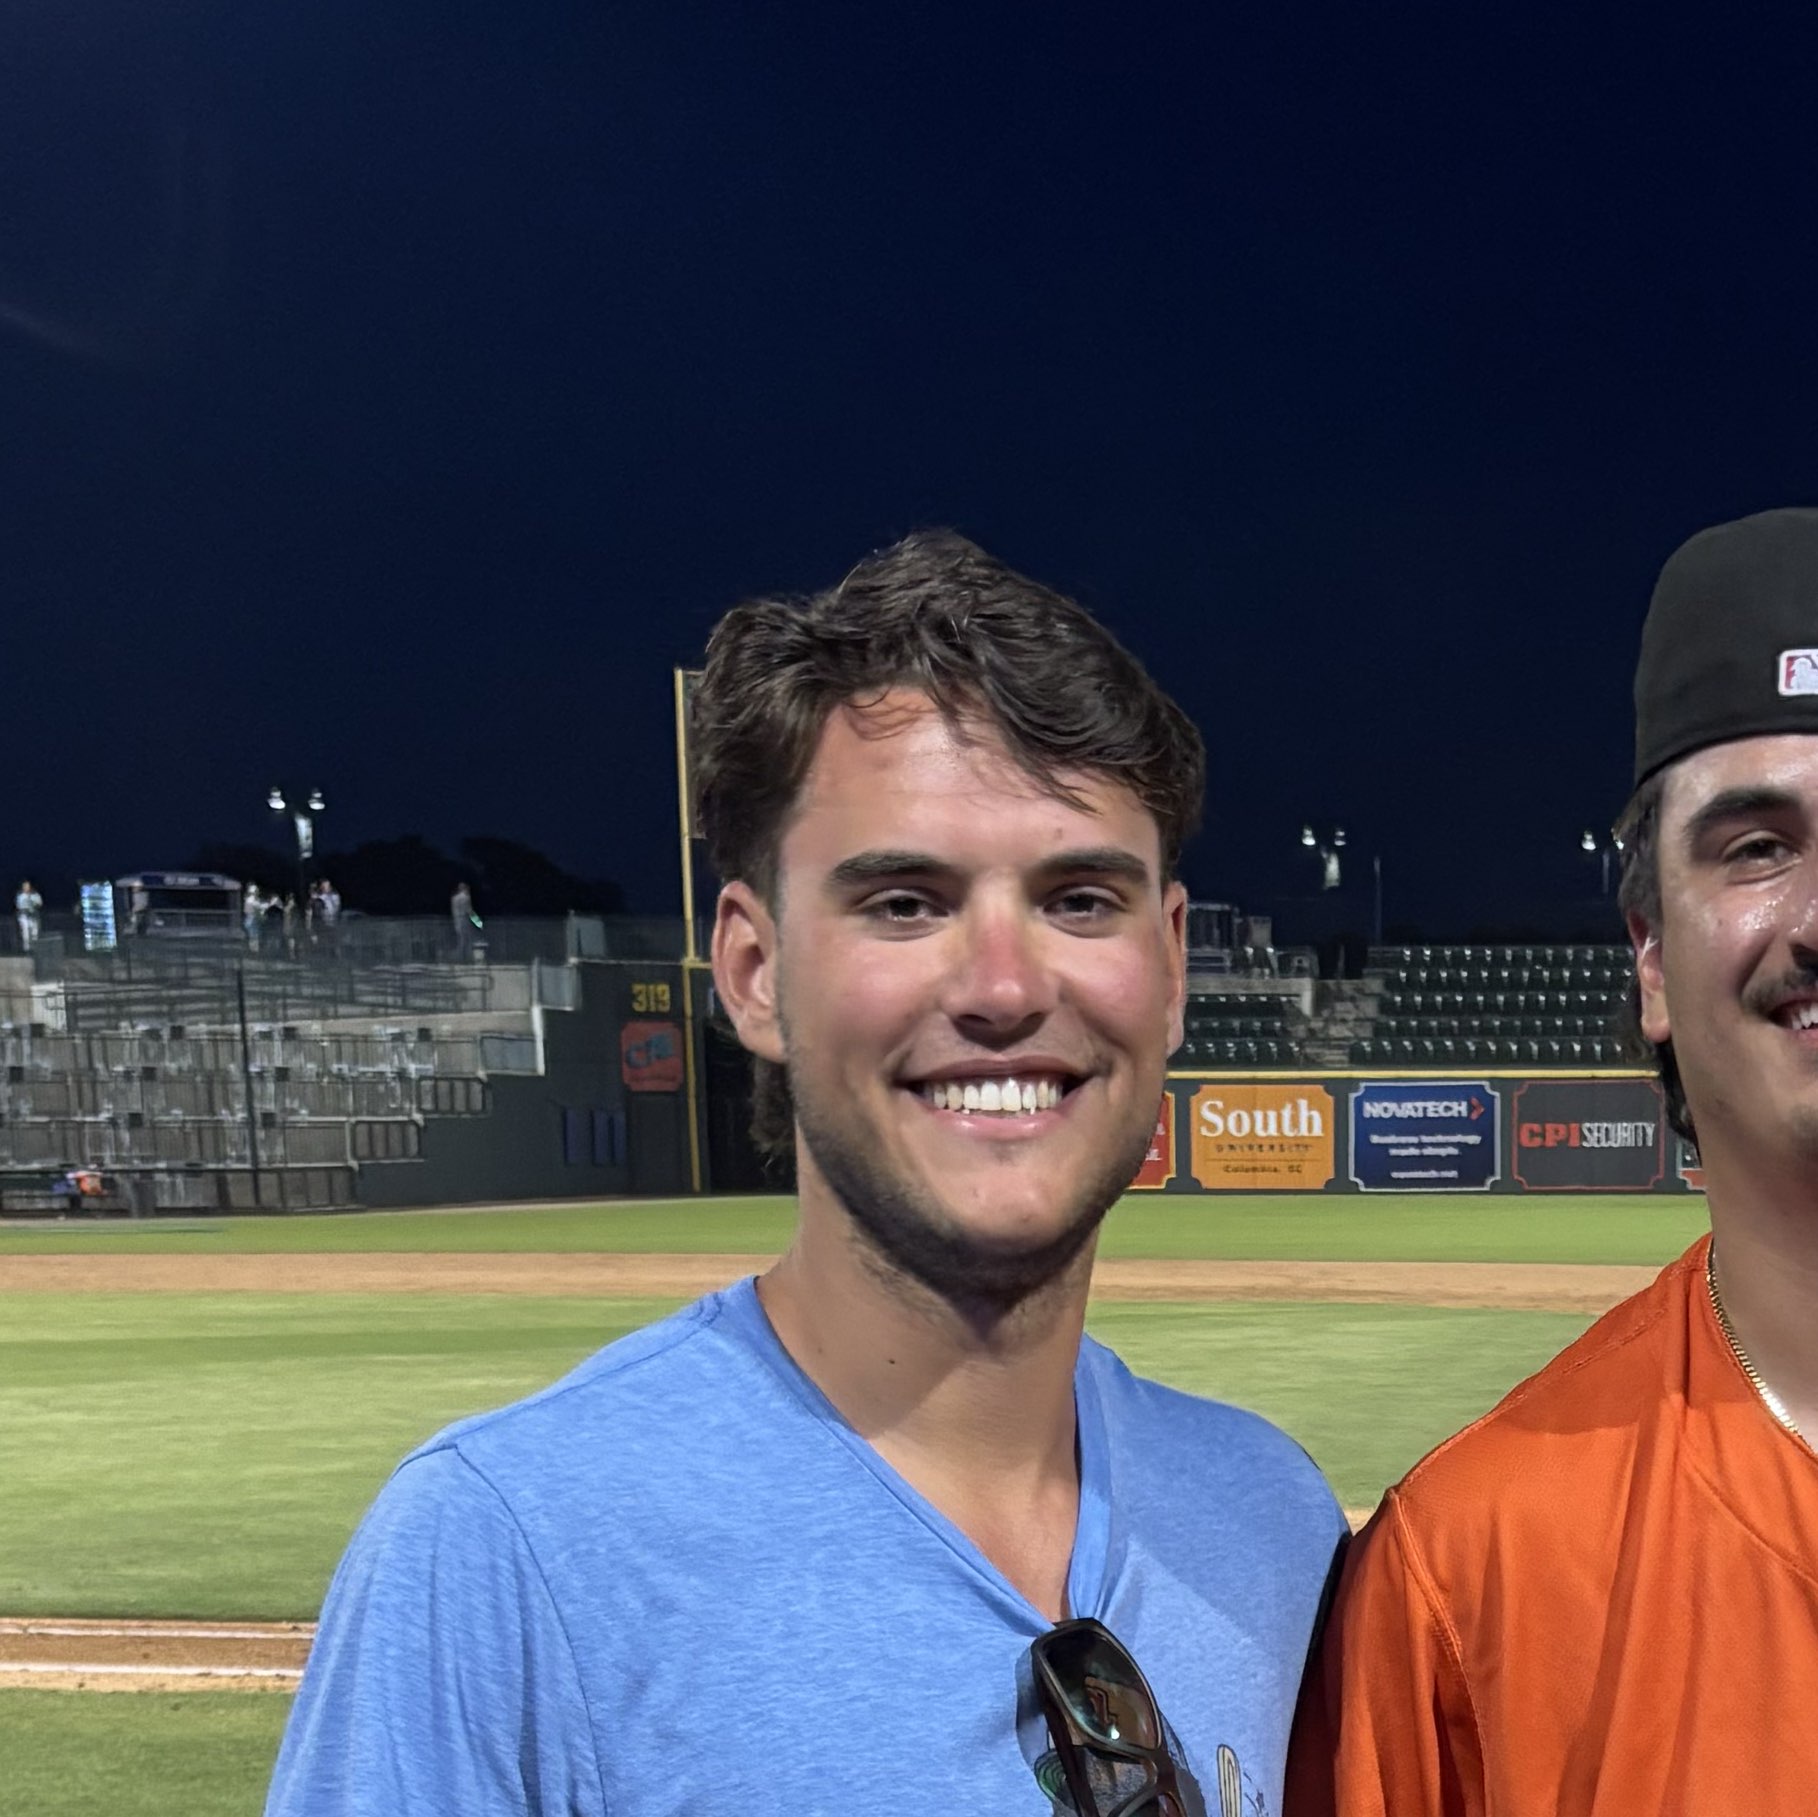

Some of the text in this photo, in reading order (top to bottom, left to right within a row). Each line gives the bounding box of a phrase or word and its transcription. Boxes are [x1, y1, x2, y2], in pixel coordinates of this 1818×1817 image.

[1200, 1098, 1324, 1137] South
[1363, 1101, 1468, 1118] NOVATECH
[1519, 1122, 1656, 1147] CPI SECURITY
